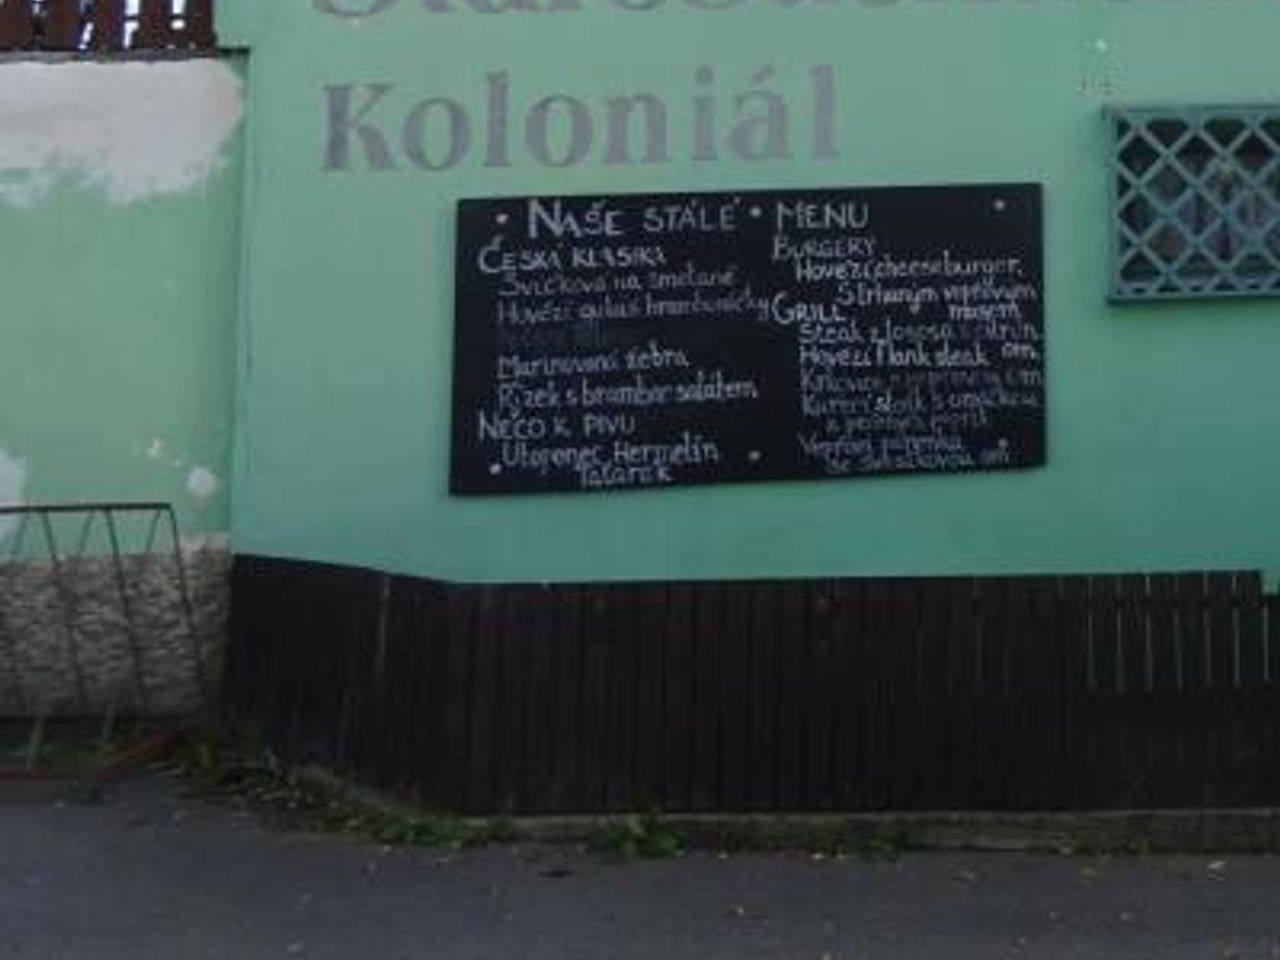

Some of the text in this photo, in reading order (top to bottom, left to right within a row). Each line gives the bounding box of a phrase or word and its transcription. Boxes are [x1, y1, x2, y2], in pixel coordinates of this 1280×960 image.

[319, 63, 839, 172] Koloniál
[527, 196, 869, 238] NAŠE STÁLÉ MENU
[571, 246, 667, 268] KLASIKA
[772, 234, 876, 262] BURGERY
[613, 272, 642, 290] na
[771, 290, 847, 324] GRILL
[800, 319, 864, 344] Steak
[566, 388, 578, 404] s
[582, 414, 636, 437] PIVU
